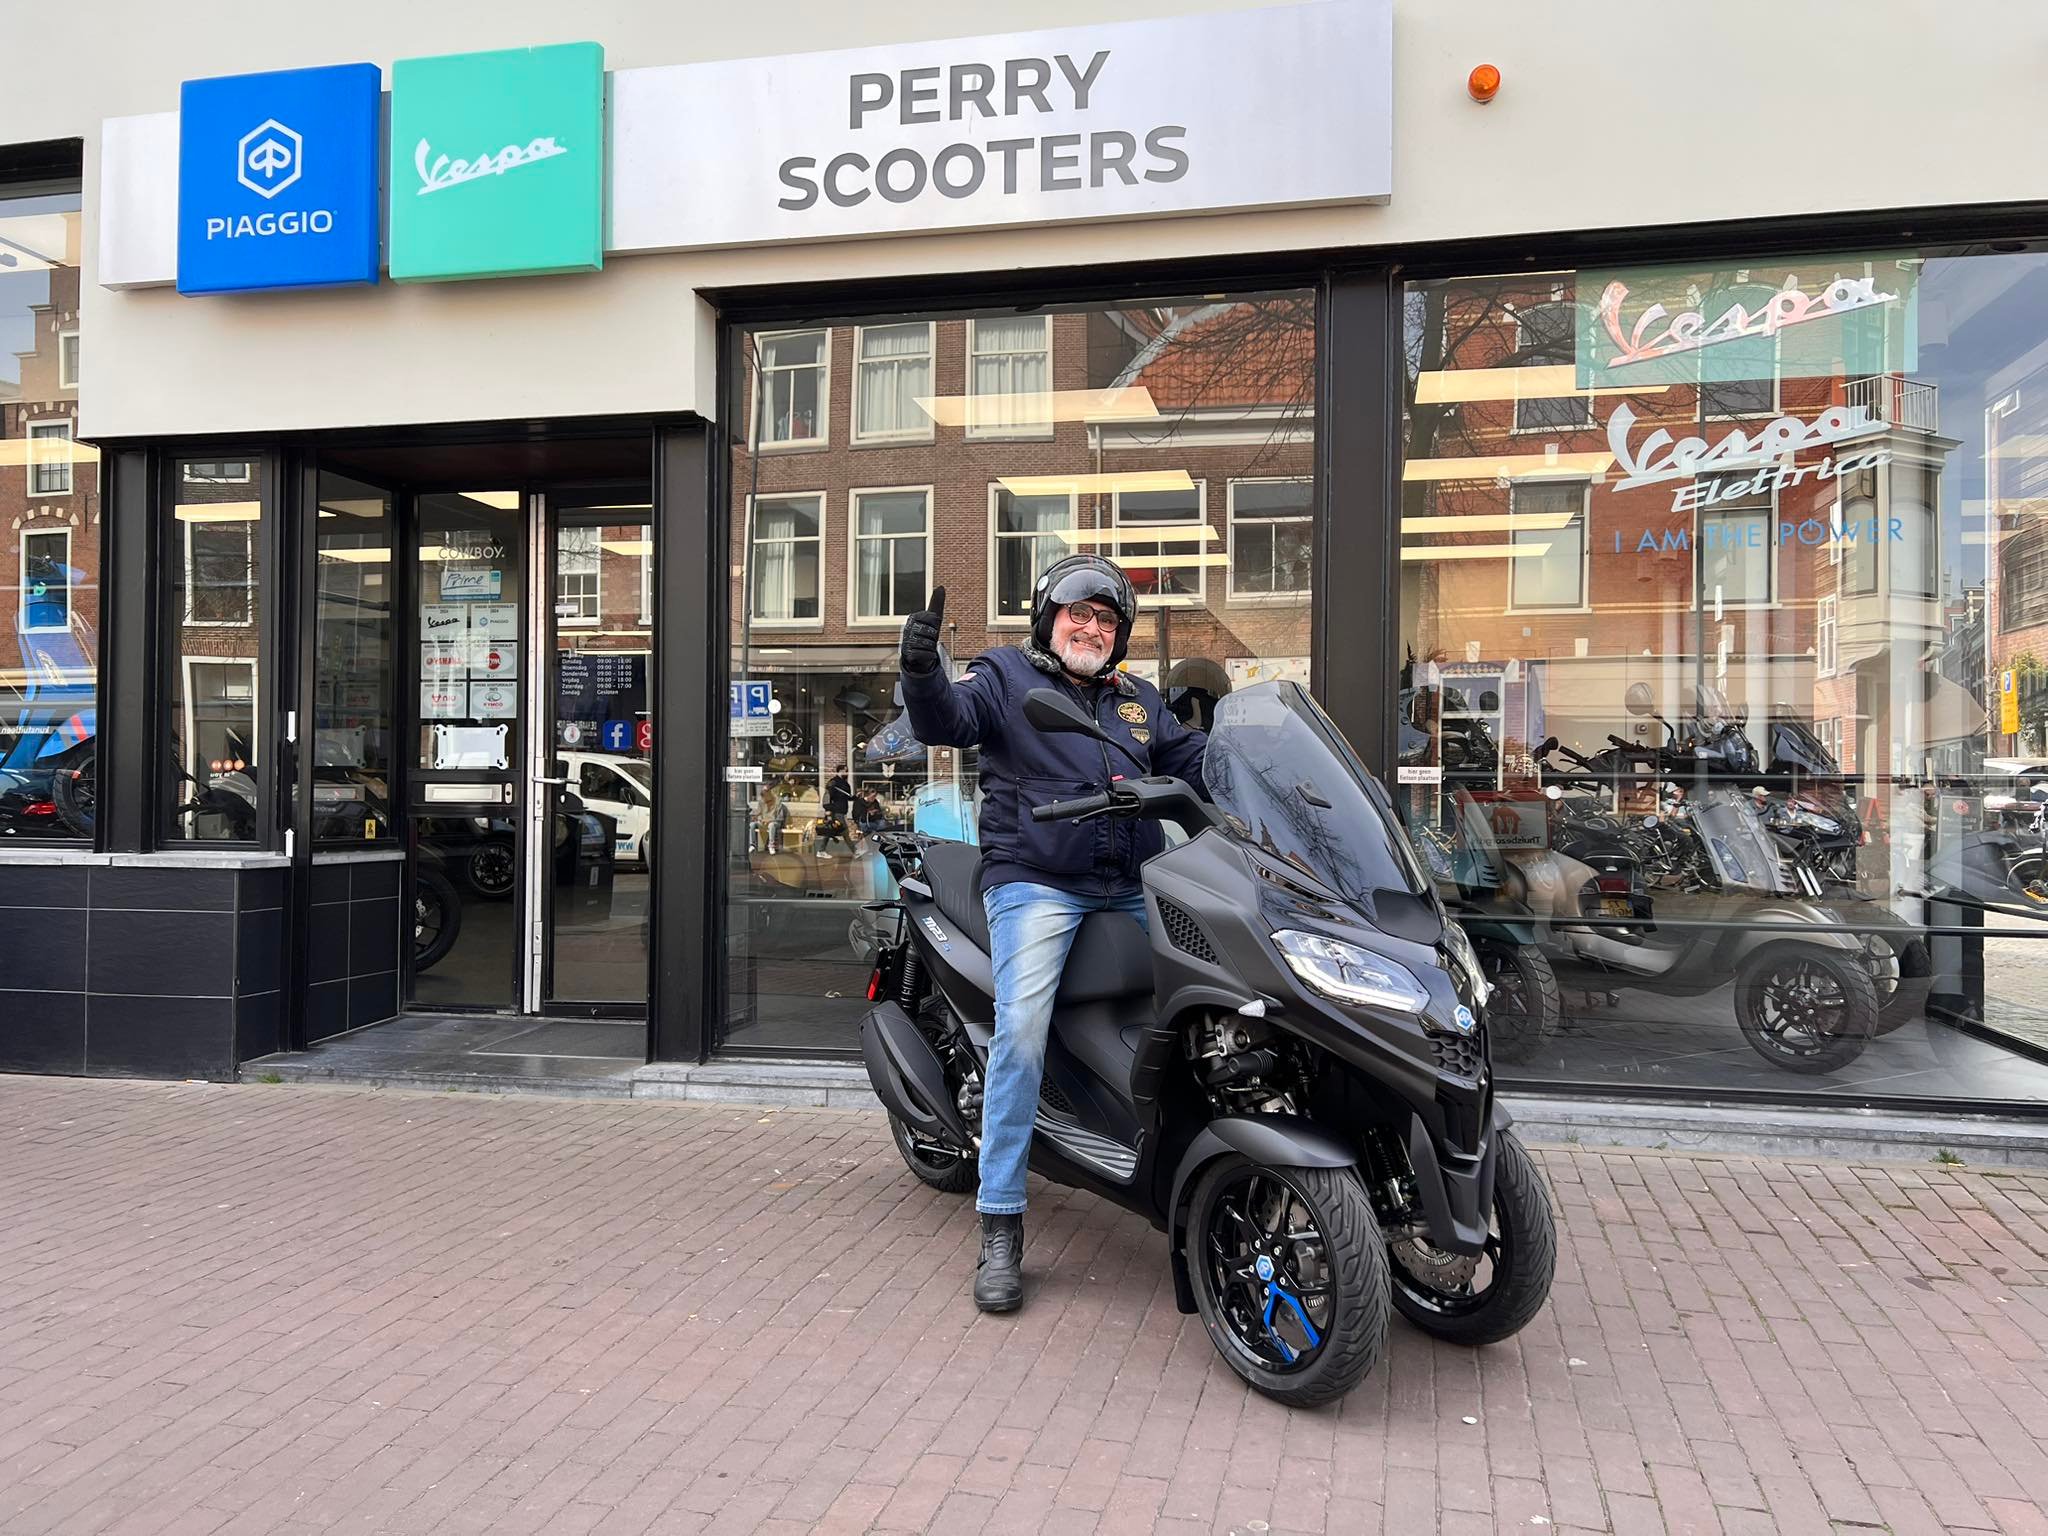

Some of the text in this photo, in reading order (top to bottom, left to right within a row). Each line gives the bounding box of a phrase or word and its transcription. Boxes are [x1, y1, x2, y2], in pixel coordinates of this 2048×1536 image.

[849, 50, 1111, 130] PERRY
[415, 136, 568, 196] Vespa
[777, 125, 1190, 211] SCOOTERS
[206, 209, 333, 240] PIAGGIO
[1601, 277, 1898, 369] Vespa
[1606, 402, 1893, 492] Vespa
[1670, 449, 1893, 513] Elettrica
[1614, 517, 1904, 554] I AM THE POWER
[428, 616, 461, 628] Vespa
